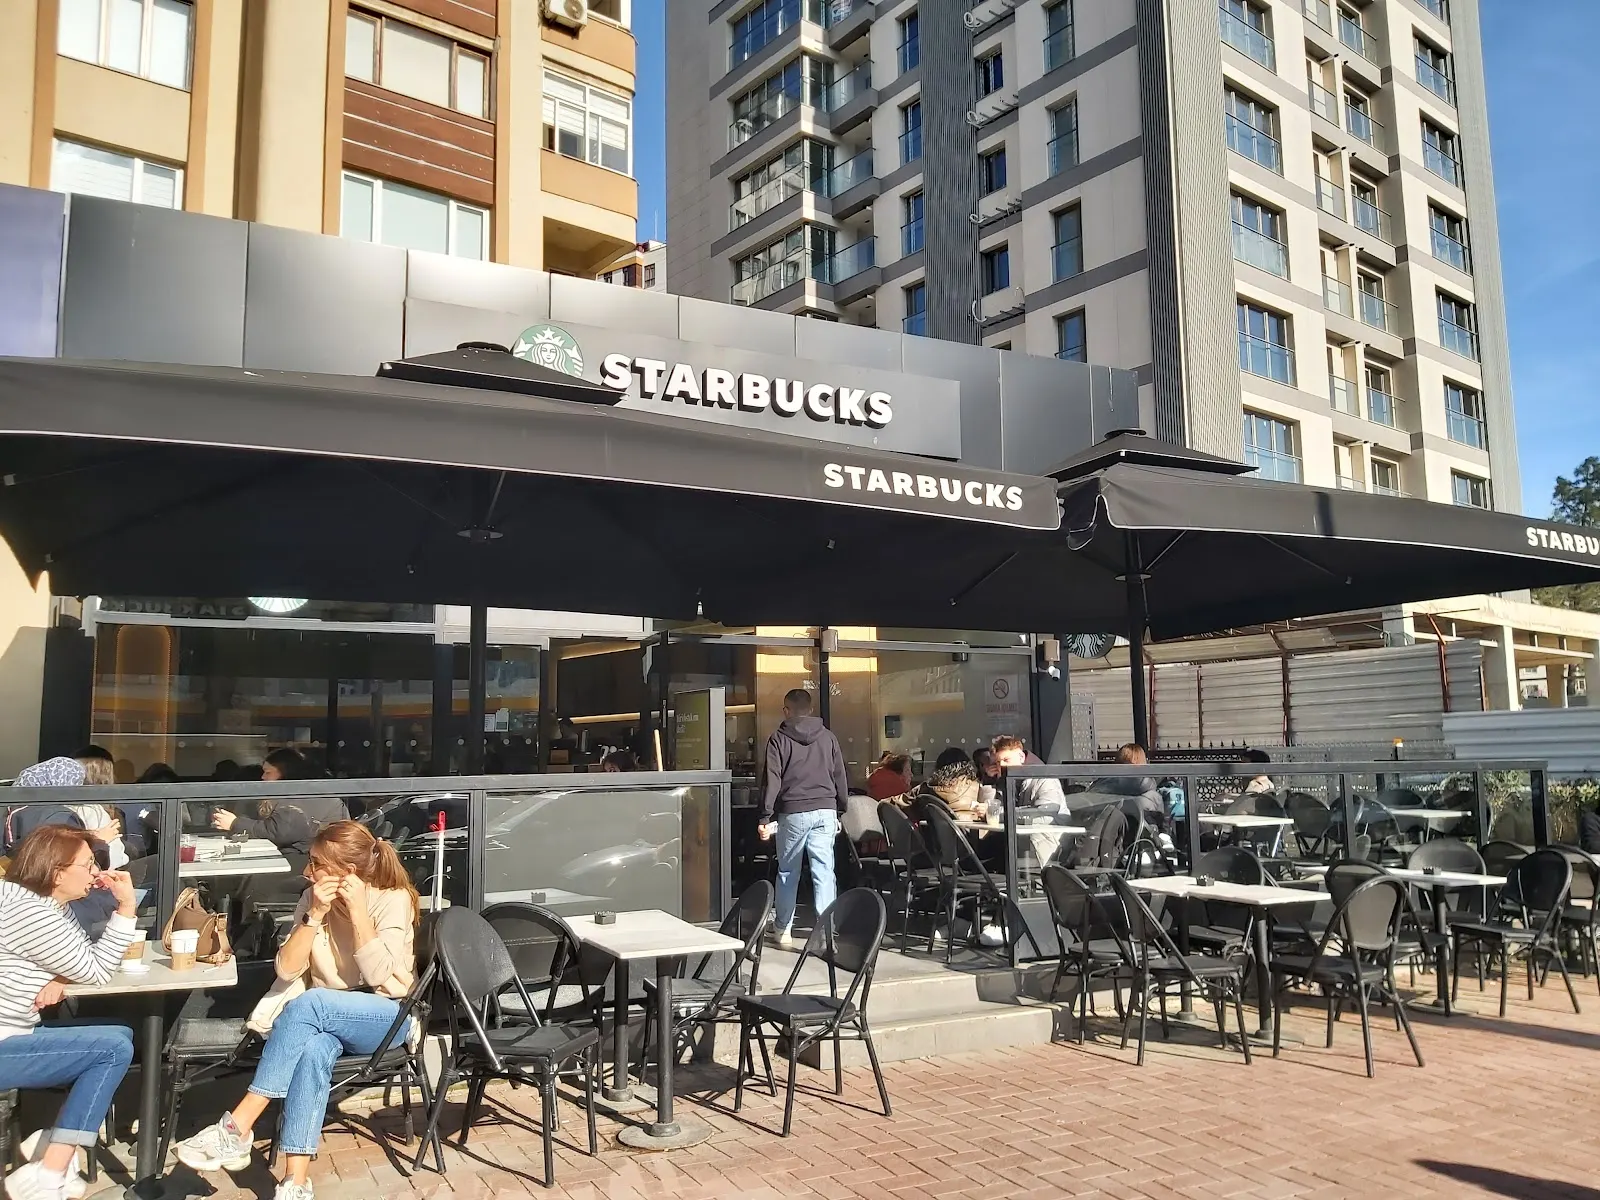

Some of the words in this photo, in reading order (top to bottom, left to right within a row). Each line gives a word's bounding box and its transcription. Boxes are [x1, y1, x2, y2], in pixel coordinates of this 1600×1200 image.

[600, 353, 893, 429] STARBUCKS
[823, 463, 1023, 511] STARBUCKS
[1526, 527, 1600, 556] STARBU
